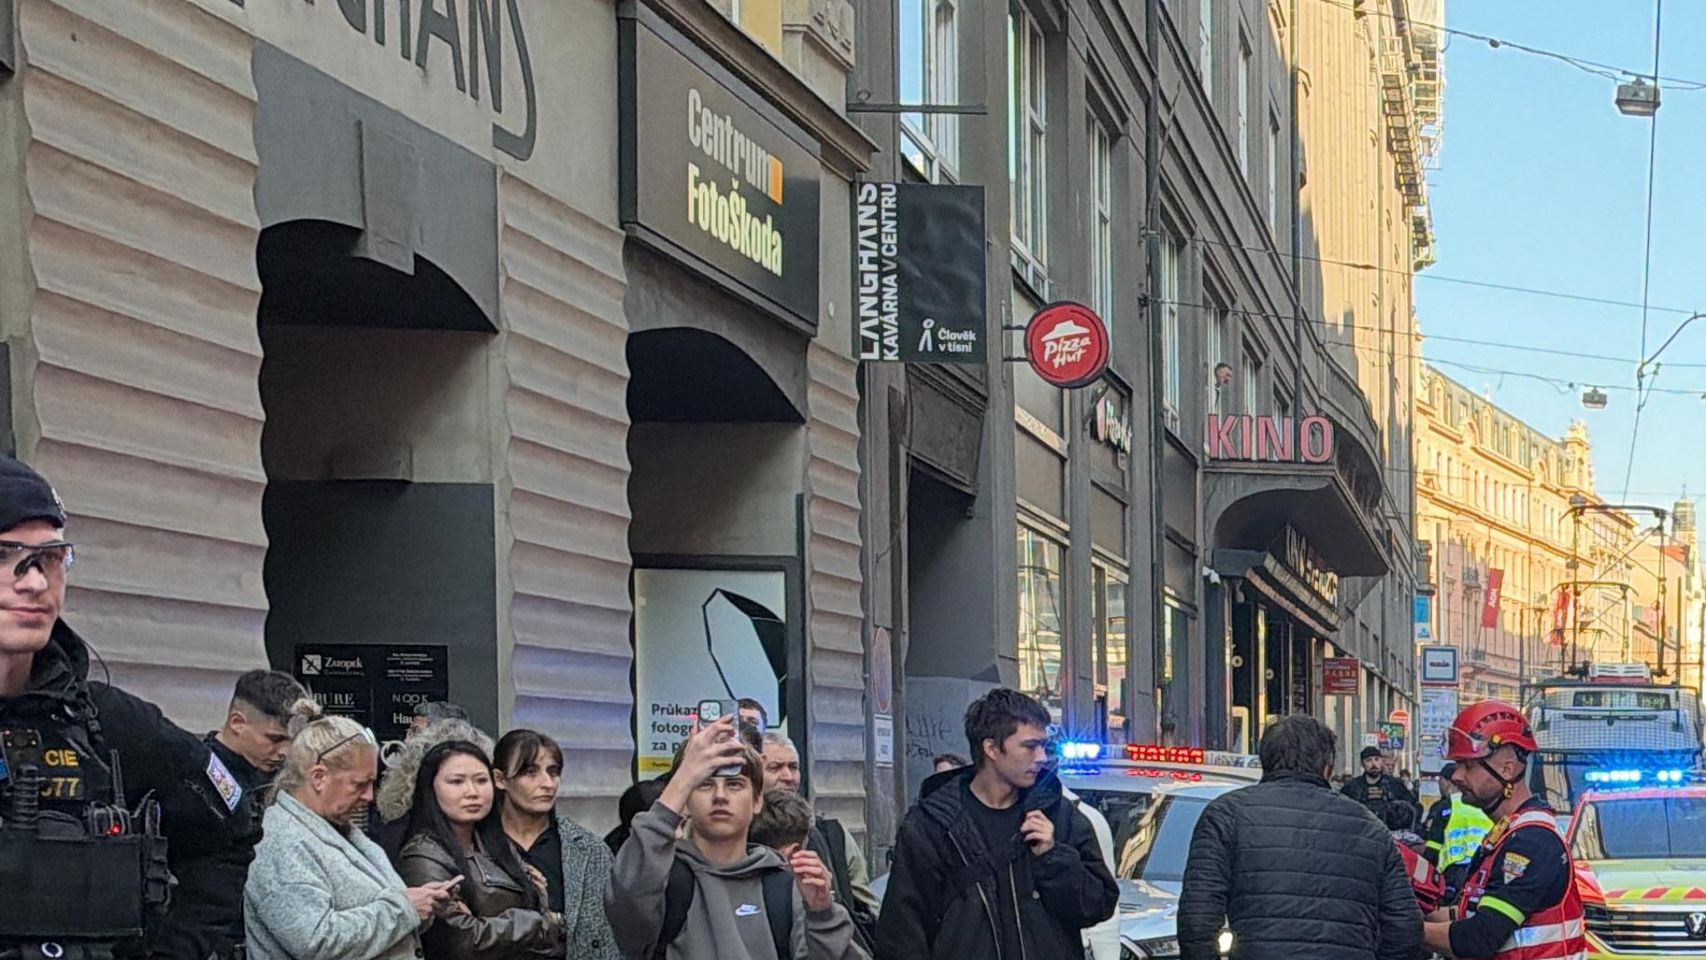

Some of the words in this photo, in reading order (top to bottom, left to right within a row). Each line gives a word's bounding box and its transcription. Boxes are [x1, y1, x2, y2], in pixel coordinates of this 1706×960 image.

[687, 87, 770, 196] Centrum
[687, 161, 783, 277] FotoŠkoda
[880, 183, 898, 257] CENTRU
[858, 183, 880, 360] LANGHANS
[879, 273, 899, 361] KAVÁRNA
[937, 327, 977, 341] Člověk
[1044, 337, 1092, 362] Pizza
[1053, 349, 1087, 369] Hut
[1208, 415, 1333, 463] KINO
[651, 703, 698, 716] Průkaz
[651, 721, 694, 737] fotogr
[652, 742, 667, 751] za
